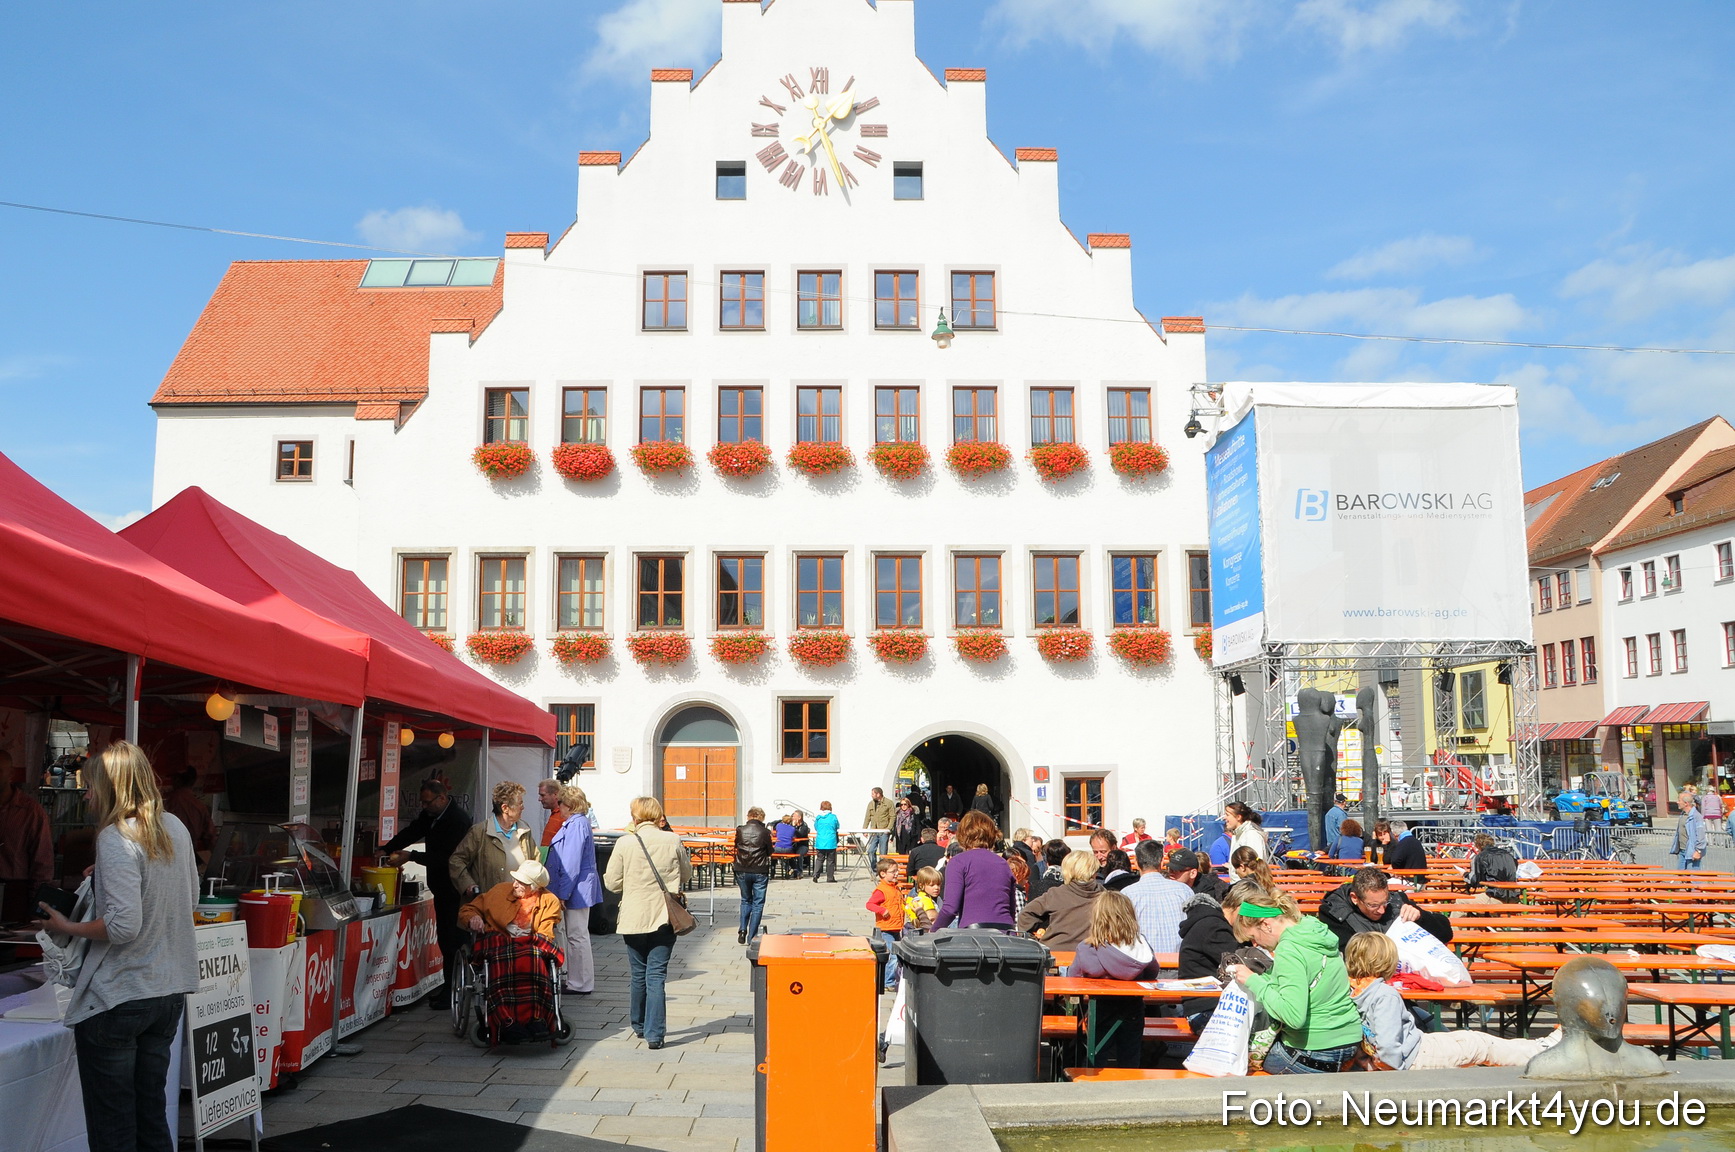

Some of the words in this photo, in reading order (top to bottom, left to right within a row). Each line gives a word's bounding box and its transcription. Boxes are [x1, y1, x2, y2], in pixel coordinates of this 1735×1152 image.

[1335, 492, 1454, 511] BAROWSKI
[1460, 492, 1493, 511] AG
[1337, 512, 1404, 521] Veranstaltungs-
[1407, 512, 1424, 520] und
[1426, 512, 1493, 521] Mediensysteme
[1342, 606, 1468, 620] www.barowski-ag.de
[198, 953, 241, 980] ENEZIA
[205, 1031, 218, 1056] 1/2
[202, 1056, 226, 1085] PIZZA
[199, 1088, 257, 1126] Lieferservice
